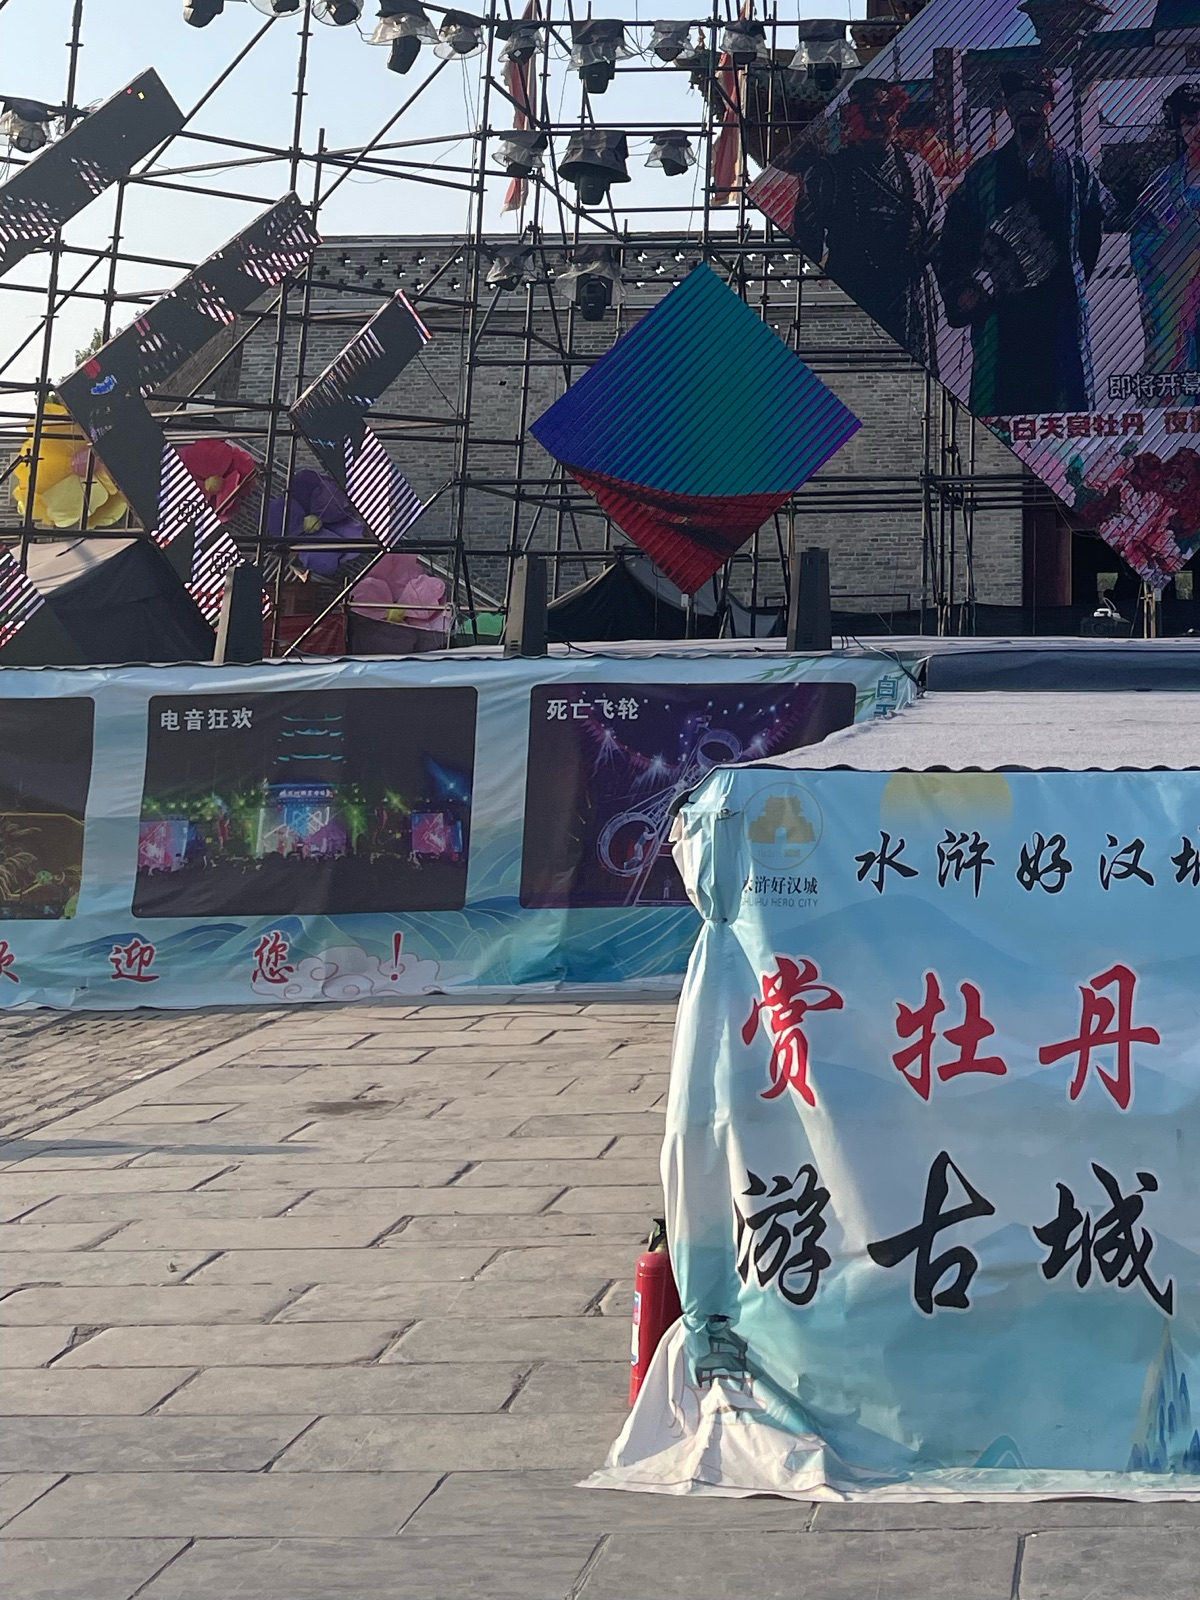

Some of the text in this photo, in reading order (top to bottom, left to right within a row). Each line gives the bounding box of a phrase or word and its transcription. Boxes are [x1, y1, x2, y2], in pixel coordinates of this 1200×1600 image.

[1012, 413, 1146, 441] 白天赏牡丹
[160, 708, 253, 731] 电音狂欢
[546, 698, 639, 721] 死亡飞轮
[771, 898, 795, 907] HERO
[798, 898, 818, 908] CITY
[742, 955, 1161, 1110] 赏牡丹
[734, 1151, 1174, 1316] 游古城
